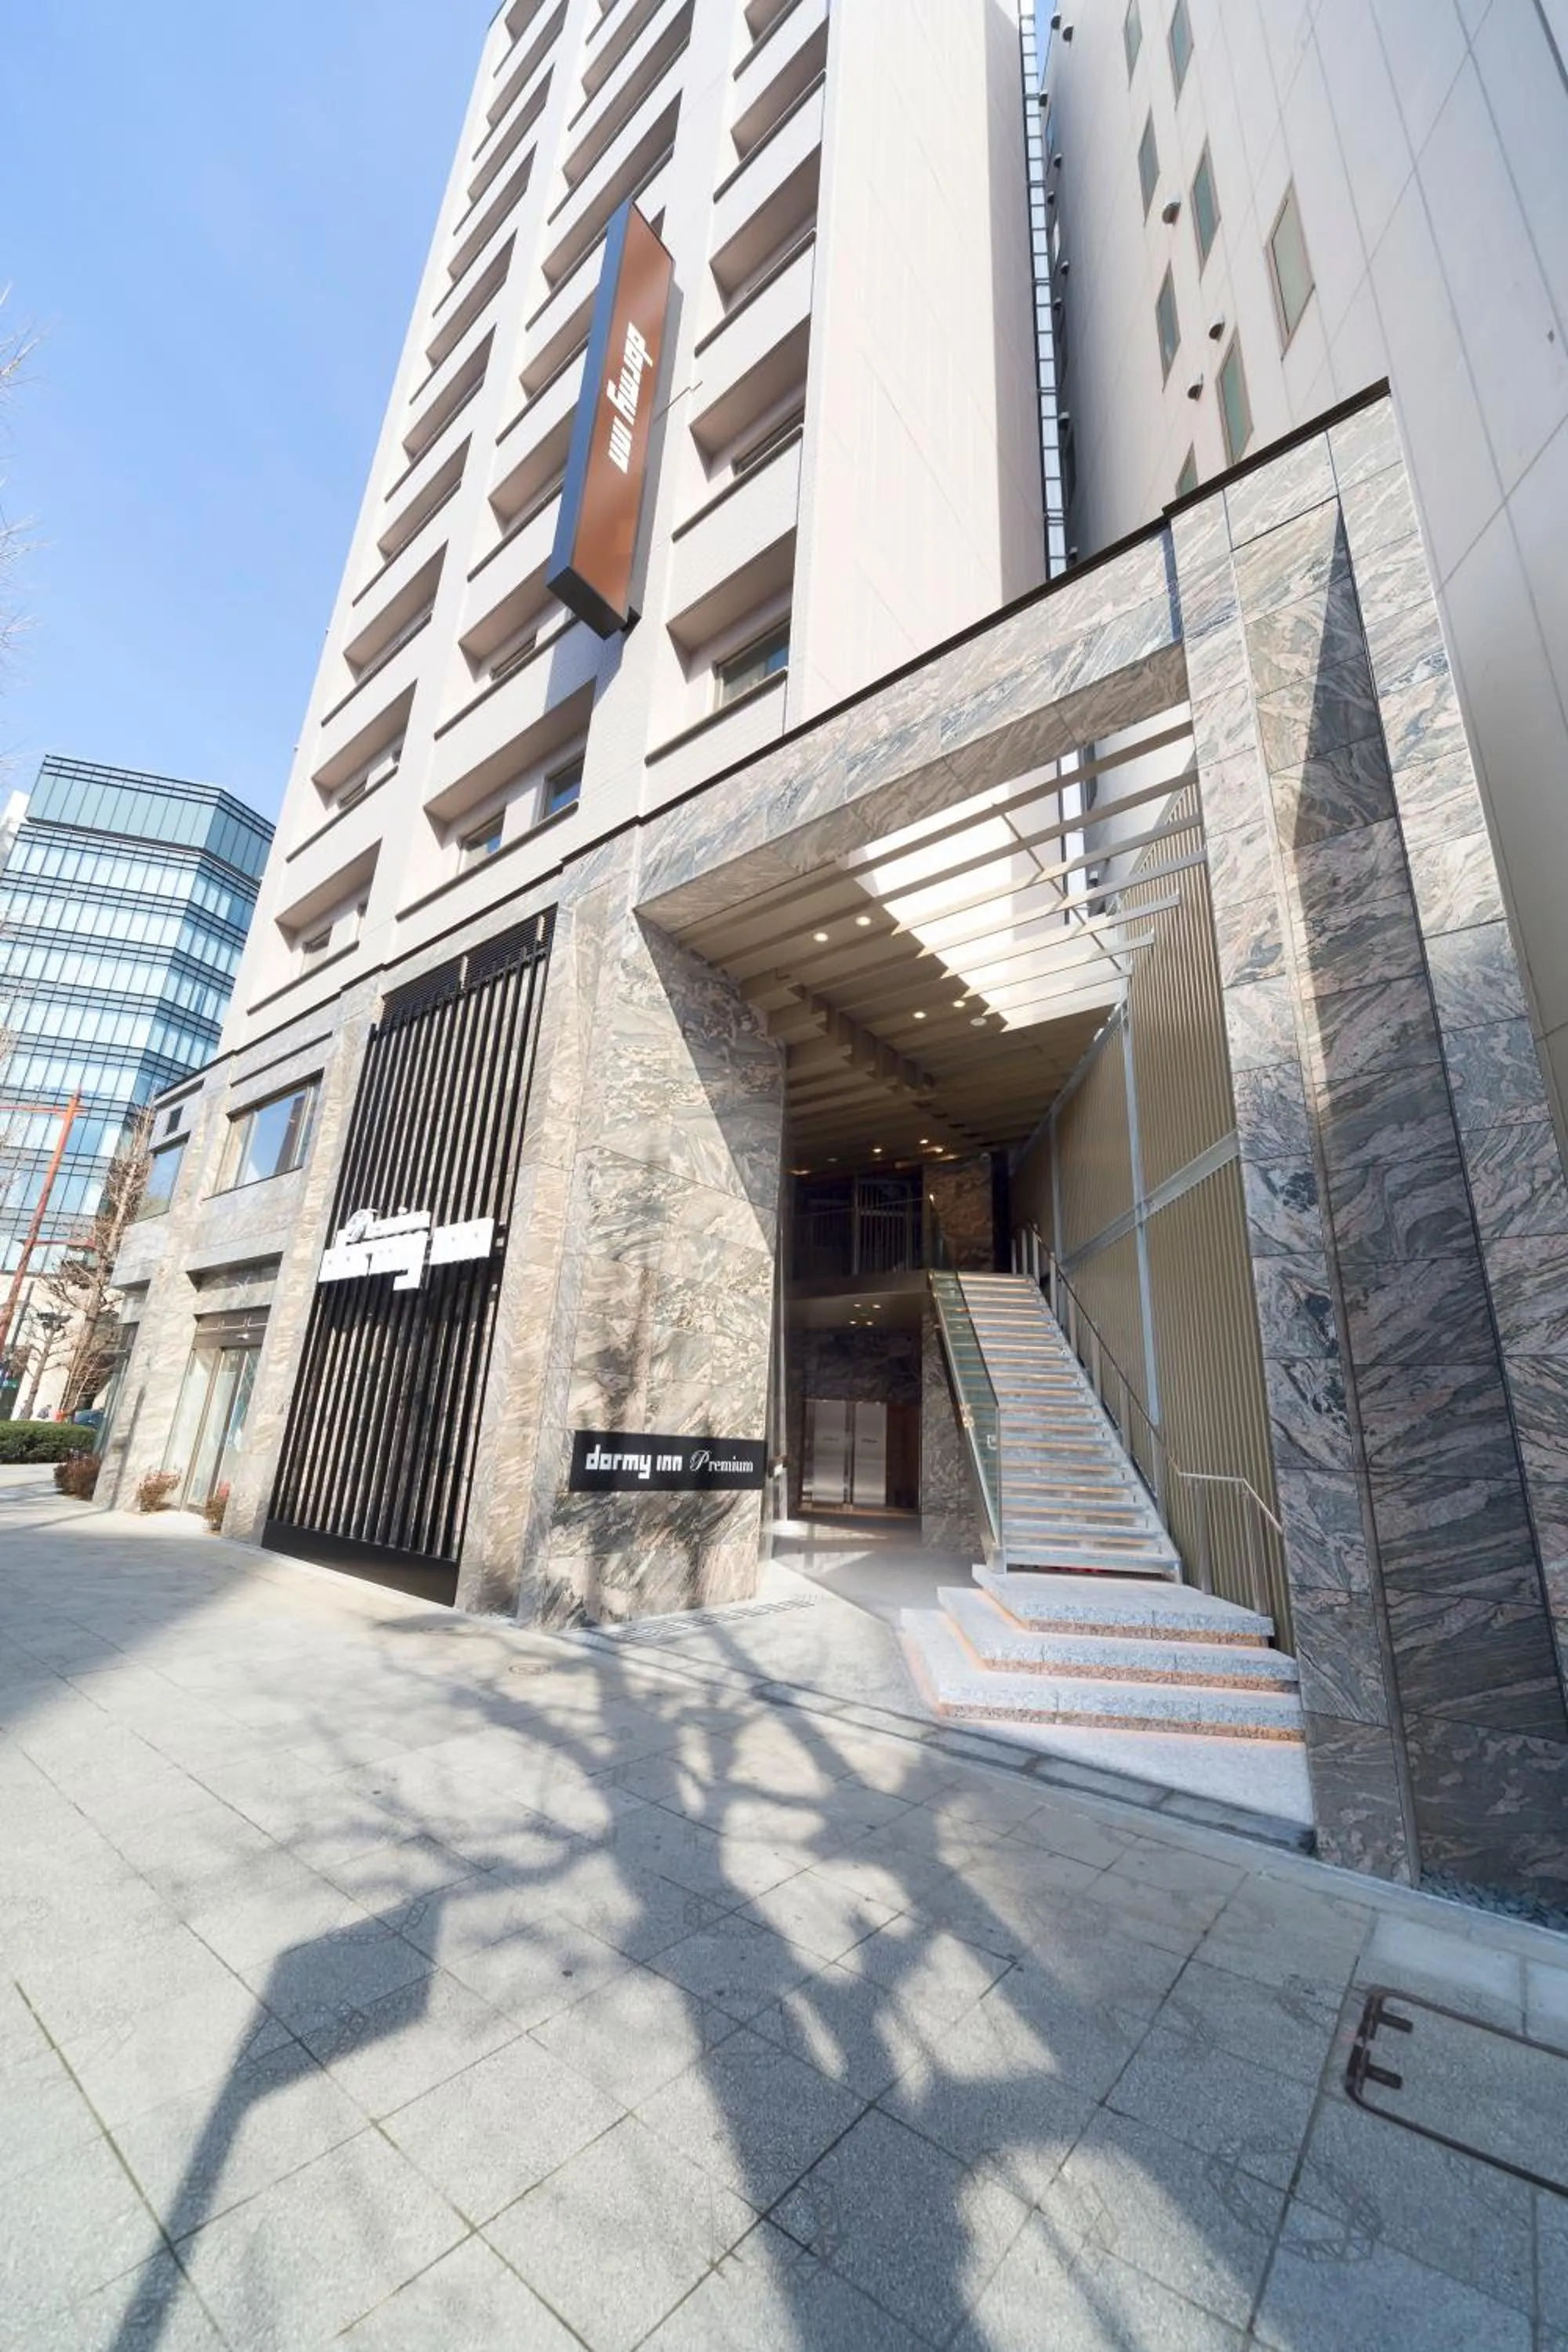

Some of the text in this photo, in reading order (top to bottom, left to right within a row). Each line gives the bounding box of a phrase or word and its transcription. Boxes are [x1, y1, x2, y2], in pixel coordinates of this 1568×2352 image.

[607, 321, 653, 474] dormy inn
[586, 1444, 753, 1479] dormy inn Premium
